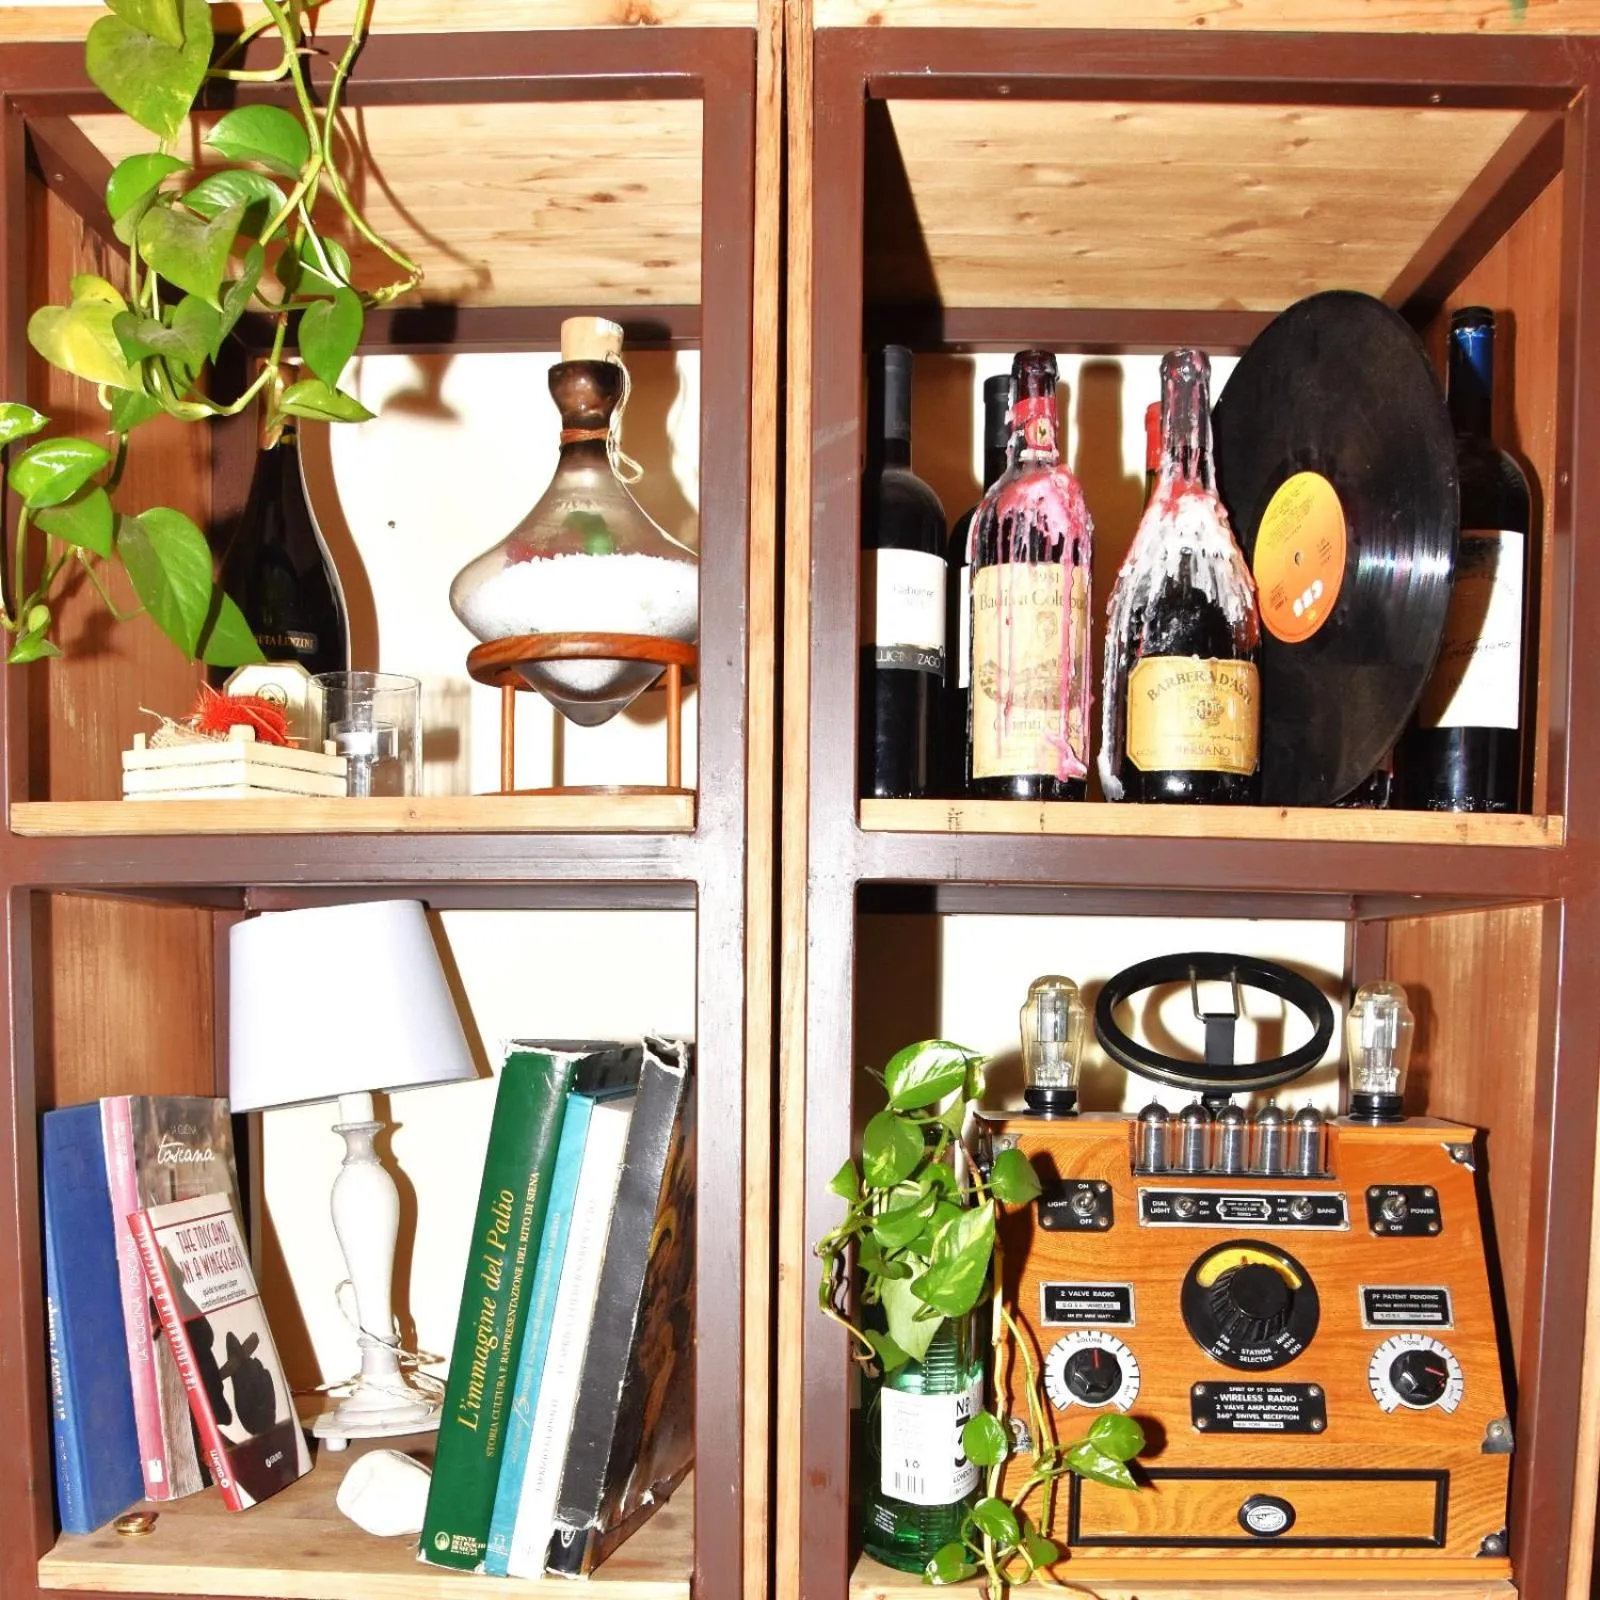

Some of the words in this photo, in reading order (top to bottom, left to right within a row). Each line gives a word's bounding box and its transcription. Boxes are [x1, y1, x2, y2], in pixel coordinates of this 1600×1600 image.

[918, 653, 941, 669] ZAGO
[1147, 670, 1217, 701] BARBERA
[525, 1172, 541, 1198] SIENA
[486, 1189, 515, 1252] Palio
[523, 1199, 535, 1213] DI
[176, 1228, 198, 1255] THE
[193, 1219, 231, 1249] TOSCANO
[519, 1214, 532, 1242] RITO
[180, 1259, 195, 1285] IN
[192, 1256, 204, 1281] A
[199, 1245, 245, 1279] WINEGLASS
[481, 1251, 504, 1292] del
[516, 1243, 528, 1265] DEL
[132, 1296, 147, 1344] CUCINA
[500, 1266, 524, 1364] RAPPRESENTAZIONE
[182, 1372, 197, 1391] THE
[455, 1296, 500, 1432] L'immagine
[492, 1377, 506, 1420] CULTURA
[1220, 1394, 1264, 1402] WIRELESS
[1267, 1394, 1297, 1403] RADIO
[486, 1420, 500, 1458] STORIA
